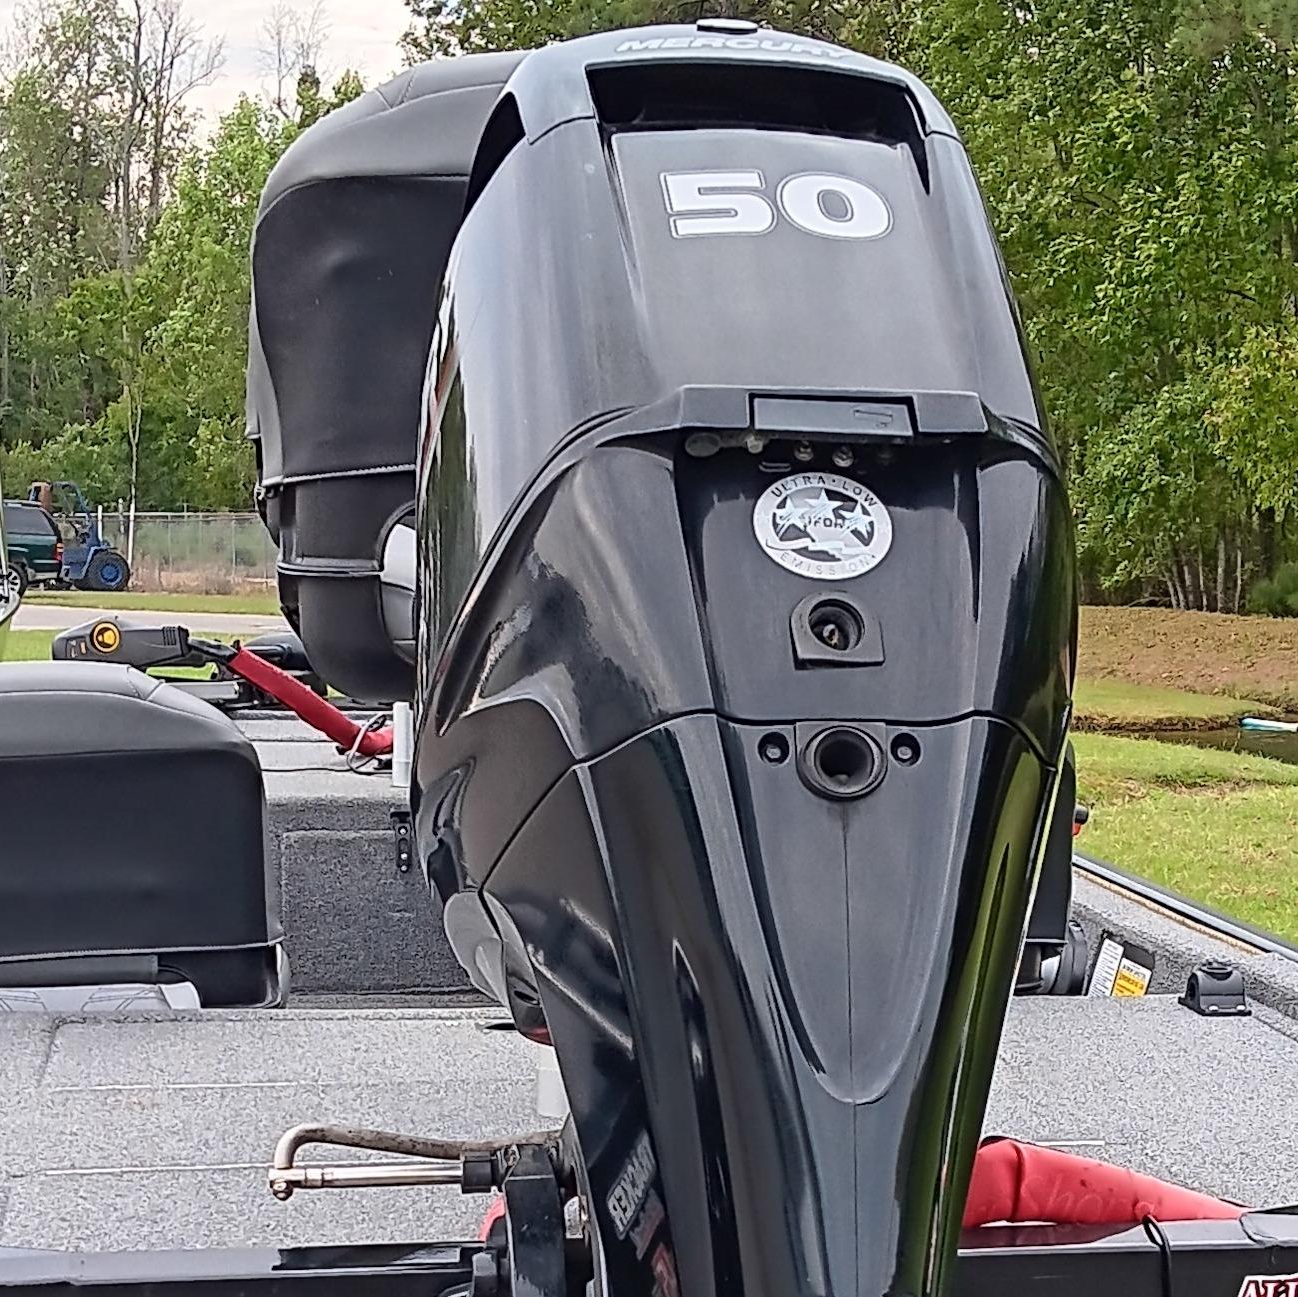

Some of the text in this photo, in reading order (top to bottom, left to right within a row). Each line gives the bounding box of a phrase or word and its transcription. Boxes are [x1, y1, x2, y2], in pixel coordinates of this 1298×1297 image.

[615, 36, 850, 59] MERCURY
[660, 169, 893, 240] 50
[771, 474, 879, 508] ULTRA LOW
[779, 551, 871, 576] EMISSON
